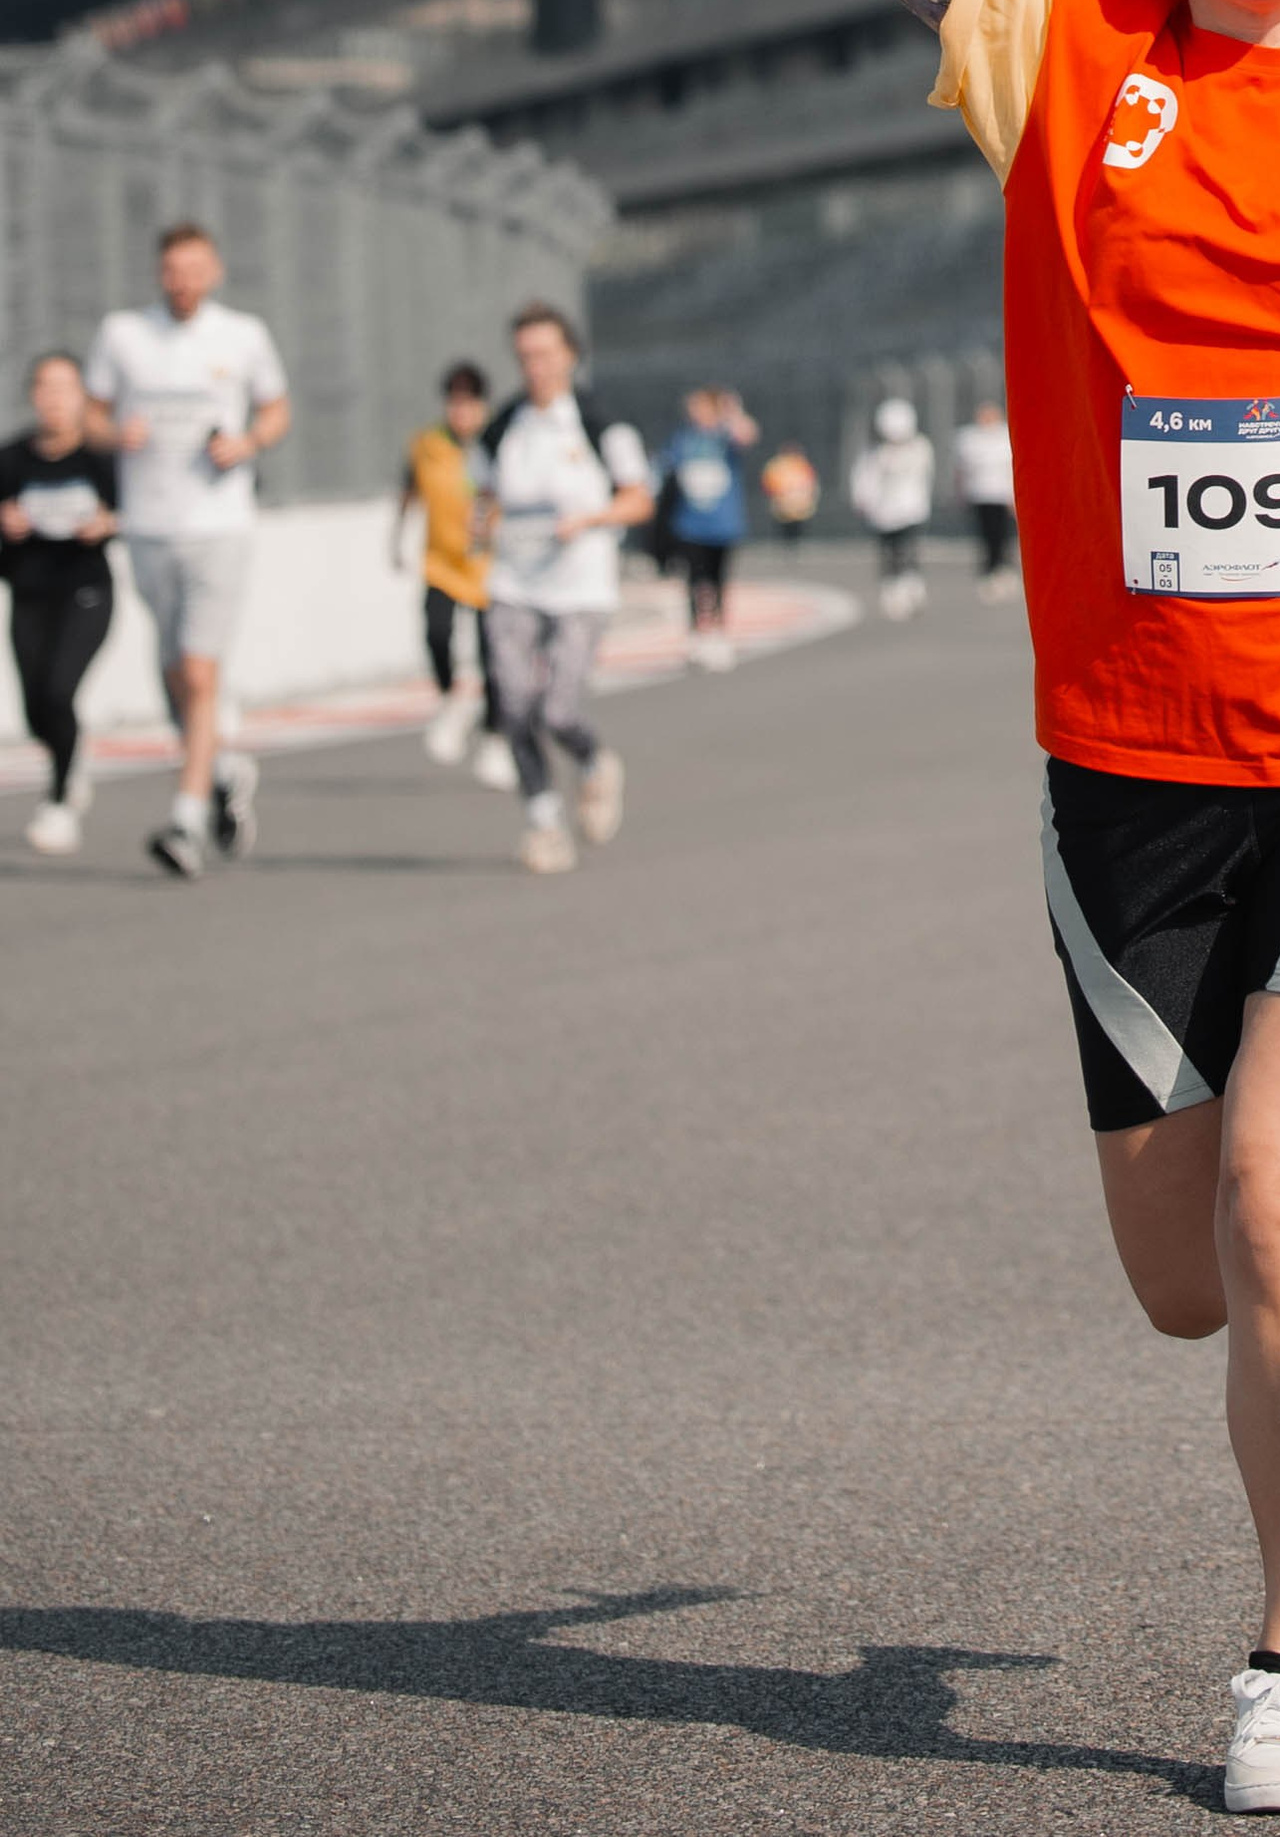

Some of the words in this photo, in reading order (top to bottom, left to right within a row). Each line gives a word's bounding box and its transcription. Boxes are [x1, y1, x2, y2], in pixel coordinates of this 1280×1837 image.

[1149, 411, 1183, 433] 4,6
[1159, 564, 1172, 572] 05
[1159, 579, 1172, 588] 03
